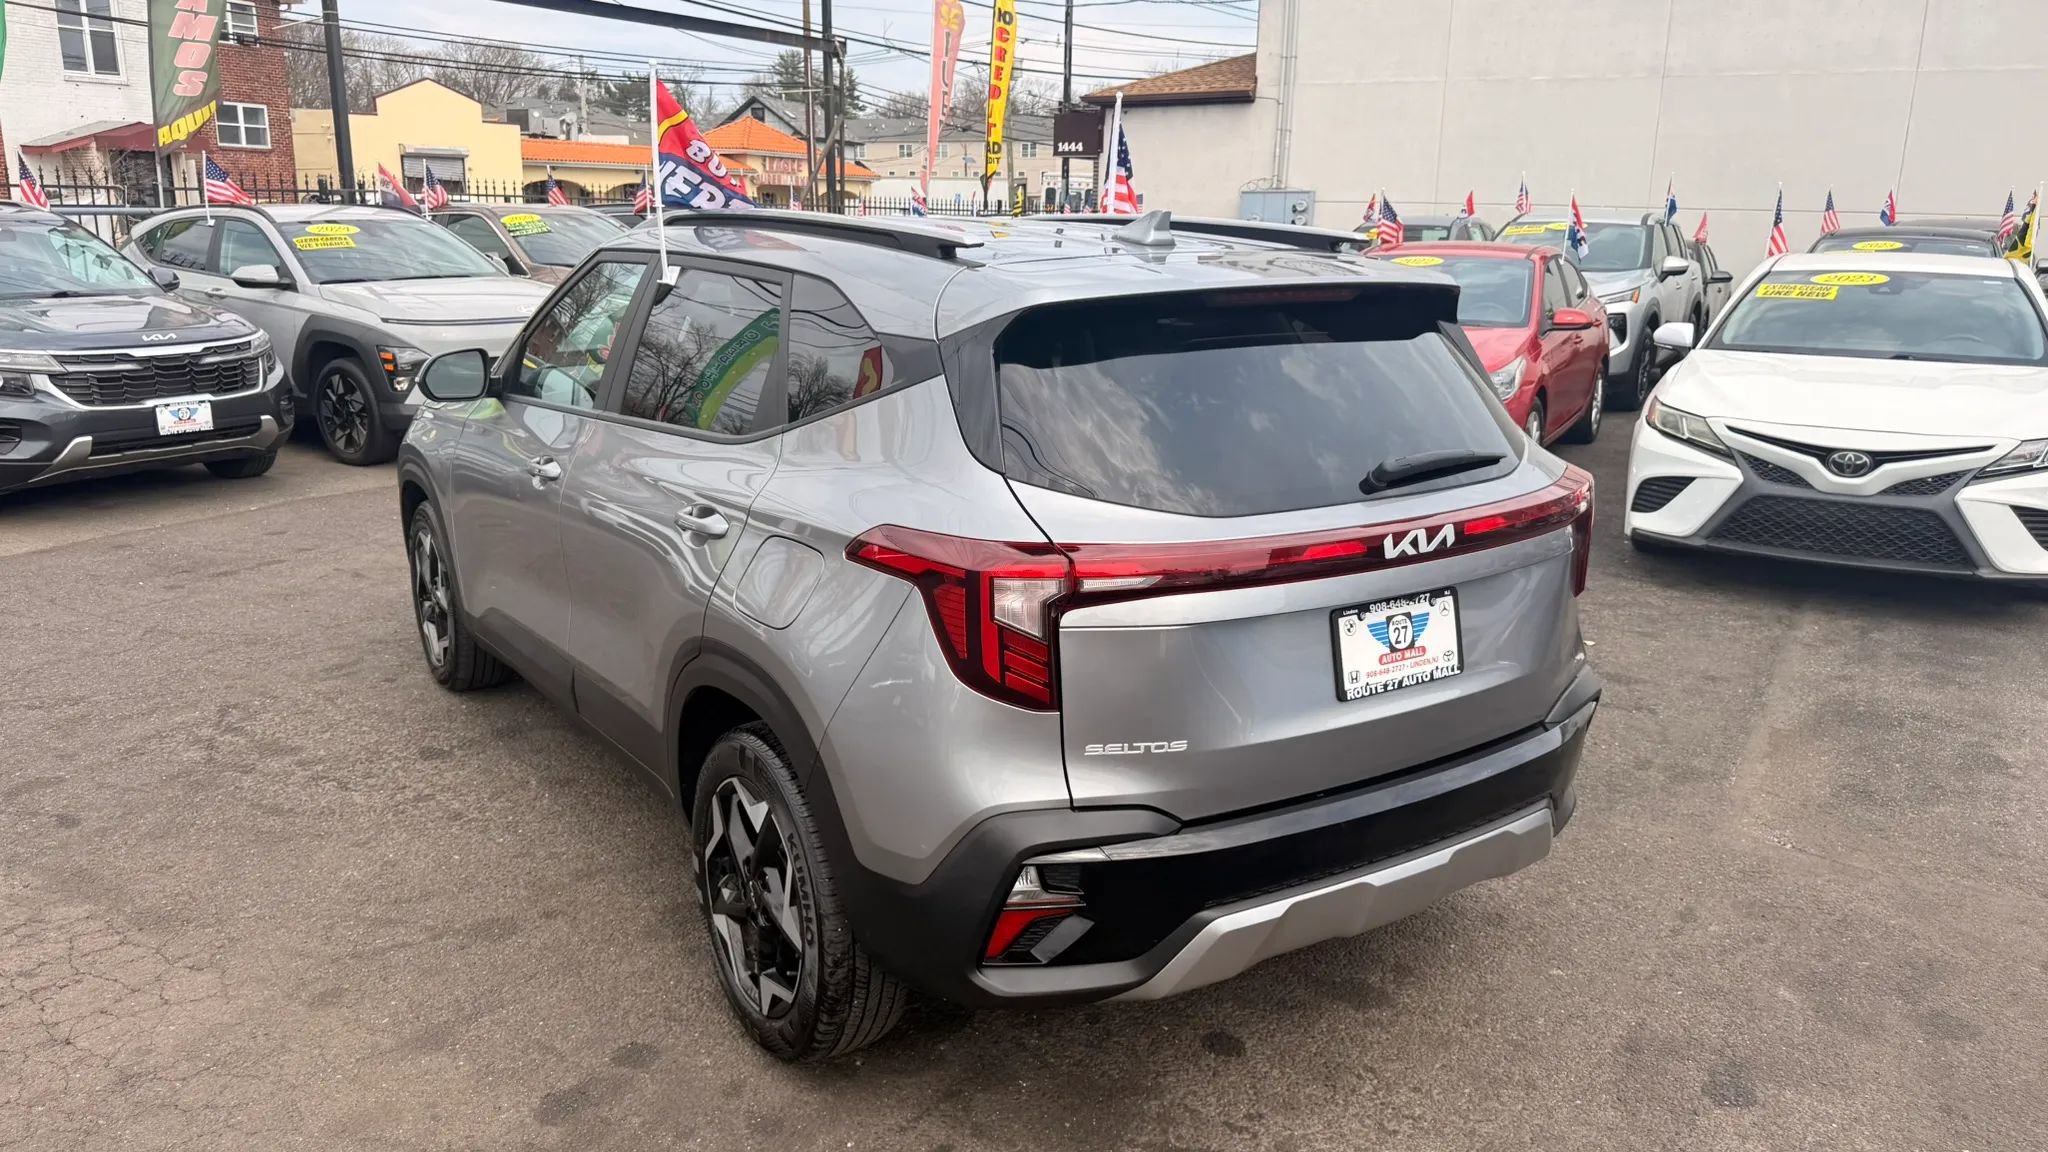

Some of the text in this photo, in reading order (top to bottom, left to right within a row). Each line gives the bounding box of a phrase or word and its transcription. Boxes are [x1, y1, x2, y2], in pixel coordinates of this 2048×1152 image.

[1058, 142, 1083, 152] 1444
[1824, 274, 1877, 282] 2023
[1796, 290, 1832, 298] NEW
[1383, 523, 1456, 559] KIA
[1343, 608, 1359, 616] Linden
[1392, 618, 1407, 626] ROUTE
[1393, 625, 1408, 645] 27
[1382, 648, 1425, 664] AUTO MALL
[1366, 663, 1406, 678] 908-648-2727
[1347, 666, 1460, 700] ROUTE 27 AUTO MALL
[1084, 740, 1188, 755] SELTOS
